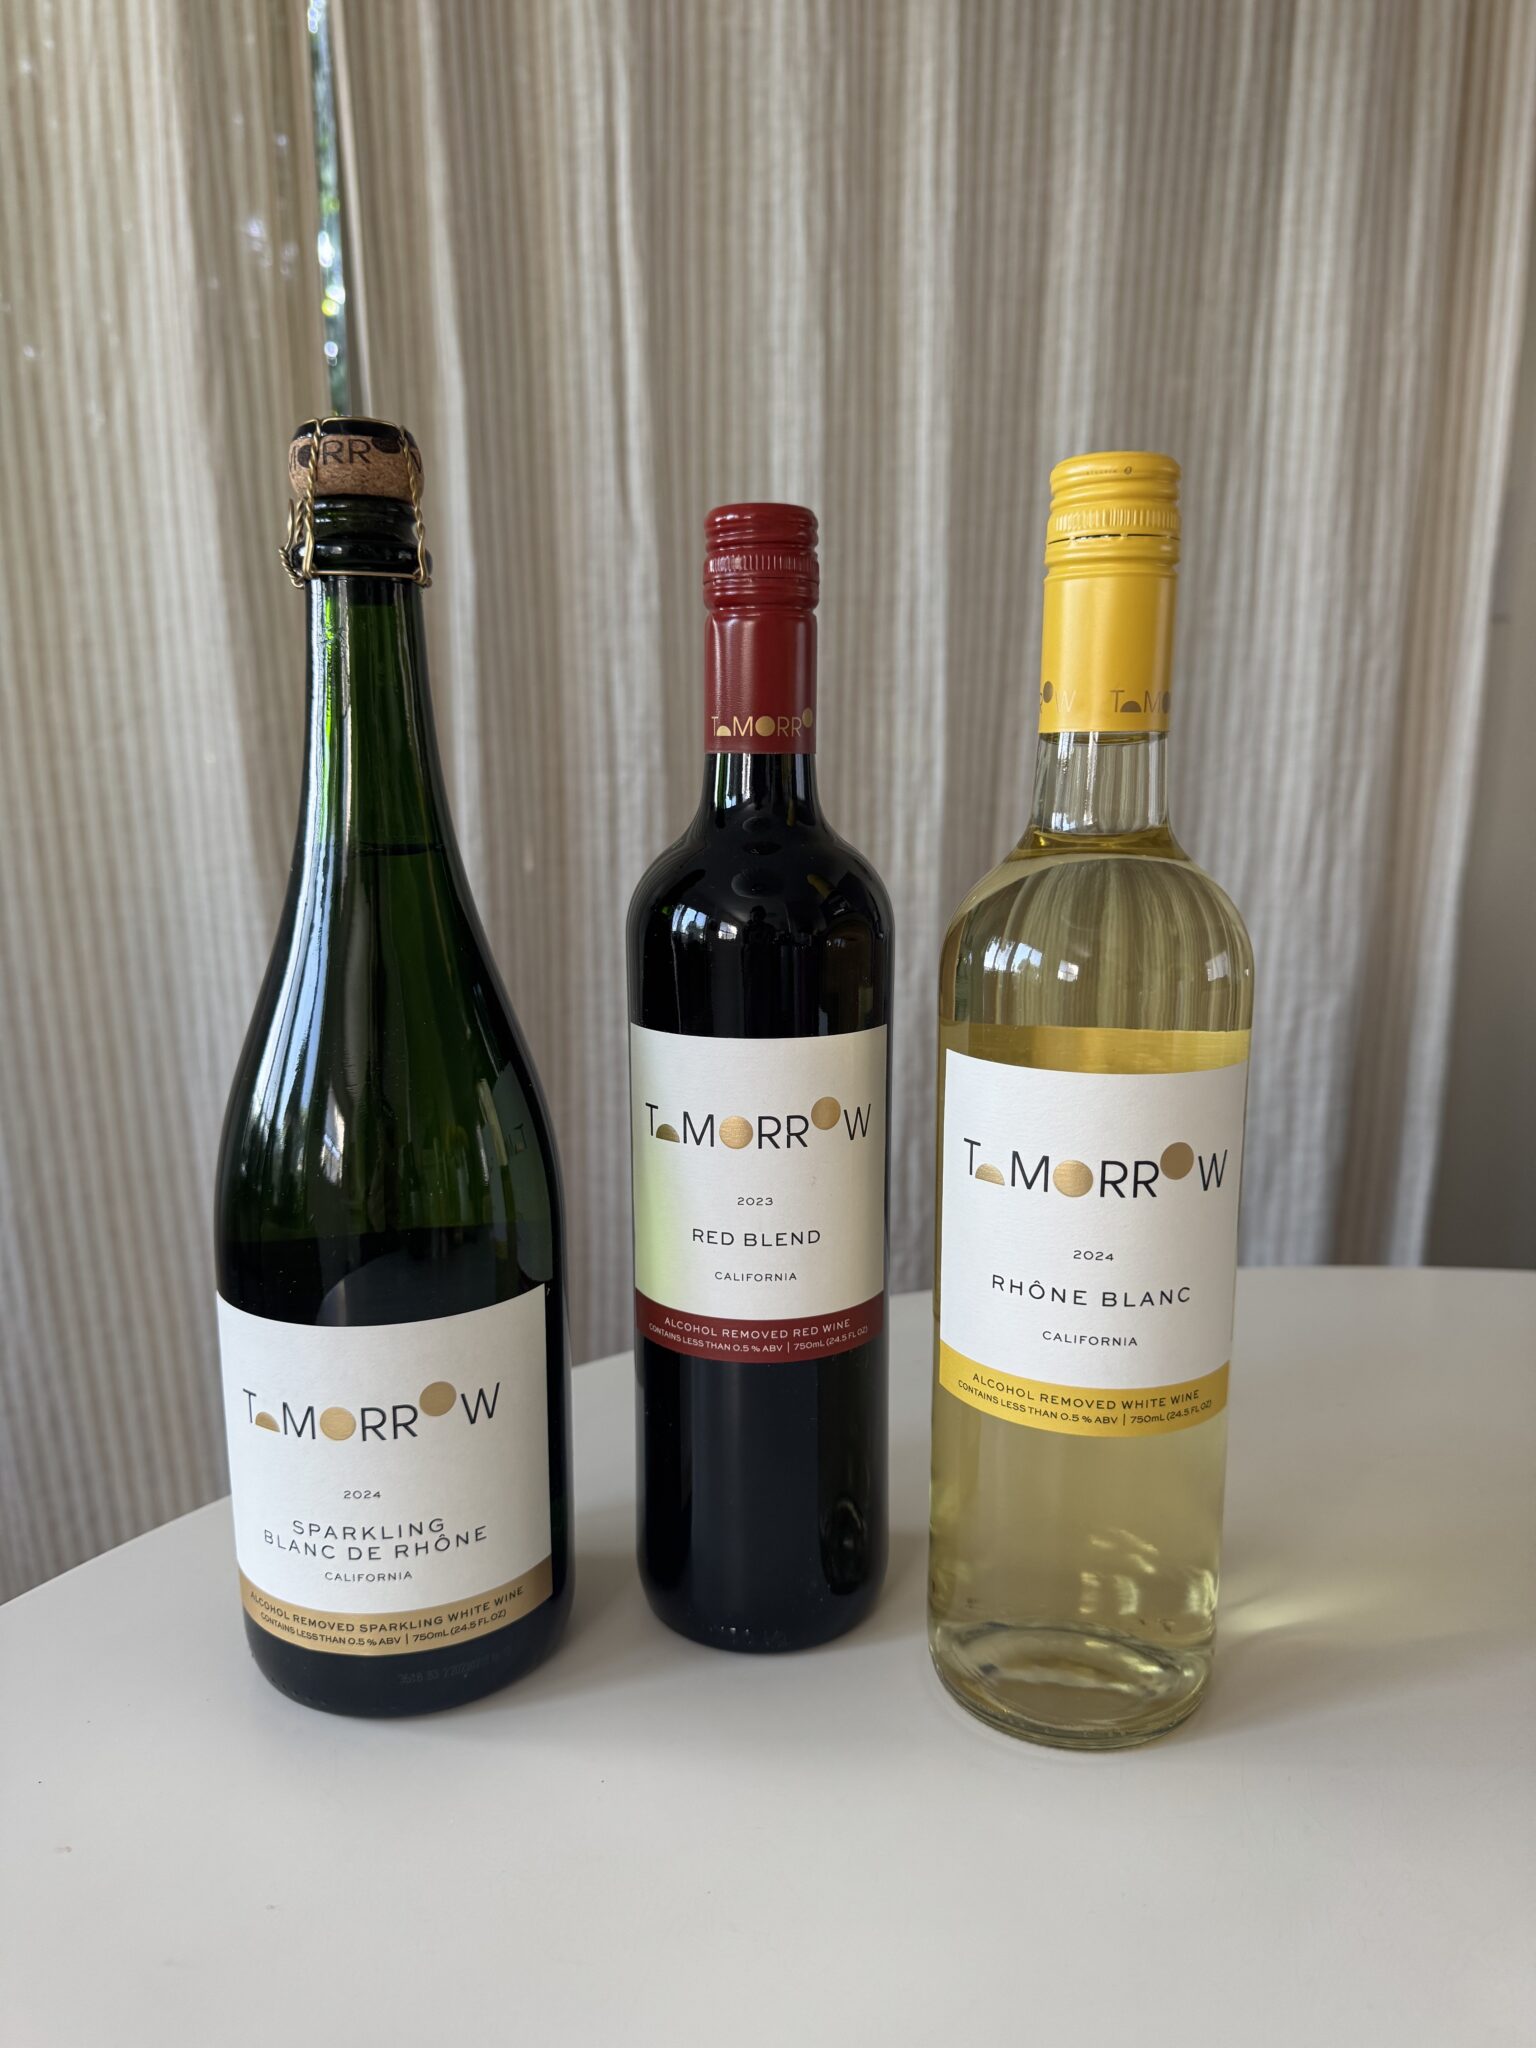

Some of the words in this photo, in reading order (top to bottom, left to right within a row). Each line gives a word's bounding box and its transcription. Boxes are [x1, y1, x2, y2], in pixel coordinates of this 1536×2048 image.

[645, 1096, 871, 1149] TOMORROW
[963, 1138, 1227, 1198] TOMORROW
[737, 1197, 774, 1206] 2023
[692, 1228, 734, 1246] RED
[744, 1230, 821, 1246] BLEND
[1073, 1250, 1114, 1261] 2024
[715, 1271, 797, 1282] CALIFORNIA
[992, 1274, 1087, 1306] RHÔNE
[1102, 1287, 1191, 1307] BLANC
[649, 1323, 682, 1342] CONTAINS
[683, 1337, 704, 1348] LESS
[705, 1342, 731, 1351] THAN
[733, 1343, 749, 1352] 0.5
[762, 1344, 782, 1352] ABV
[794, 1339, 825, 1350] 750mL
[826, 1333, 847, 1346] (24.5
[848, 1331, 857, 1340] FL
[664, 1317, 717, 1337] ALCOHOL
[723, 1329, 788, 1339] REMOVED
[794, 1327, 818, 1337] RED
[823, 1318, 850, 1333] WINE
[1042, 1331, 1138, 1346] CALIFORNIA
[958, 1379, 1000, 1405] CONTAINS
[1001, 1400, 1027, 1414] LESS
[1029, 1407, 1058, 1419] THAN
[1061, 1412, 1079, 1422] 0.5
[1082, 1415, 1092, 1423] %
[1094, 1414, 1118, 1424] ABV
[1130, 1410, 1166, 1424] 750mL
[1167, 1406, 1190, 1421] (24.5
[1191, 1405, 1200, 1414] FL
[973, 1373, 1034, 1400] ALCOHOL
[1040, 1393, 1116, 1410] REMOVED
[1122, 1398, 1166, 1409] WHITE
[1170, 1390, 1199, 1406] WINE
[242, 1380, 500, 1442] TOMORROW
[344, 1490, 381, 1499] 2024
[264, 1530, 335, 1559] BLANC
[348, 1546, 381, 1560] DE
[395, 1525, 488, 1558] RHÔNE
[293, 1518, 445, 1540] SPARKLING
[325, 1571, 413, 1582] CALIFORNIA
[250, 1591, 290, 1620] ALCOHOL
[293, 1614, 355, 1632] REMOVED
[359, 1616, 443, 1632] SPARKLING
[448, 1602, 490, 1622] WHITE
[494, 1586, 524, 1608] WINE
[261, 1612, 295, 1635] CONTAINS
[296, 1629, 318, 1641] LESS
[319, 1634, 346, 1645] THAN
[348, 1637, 365, 1646] 0.5
[379, 1636, 401, 1646] ABV
[413, 1629, 449, 1643] 750mL
[450, 1619, 477, 1636] (24.5
[478, 1617, 490, 1629] FL
